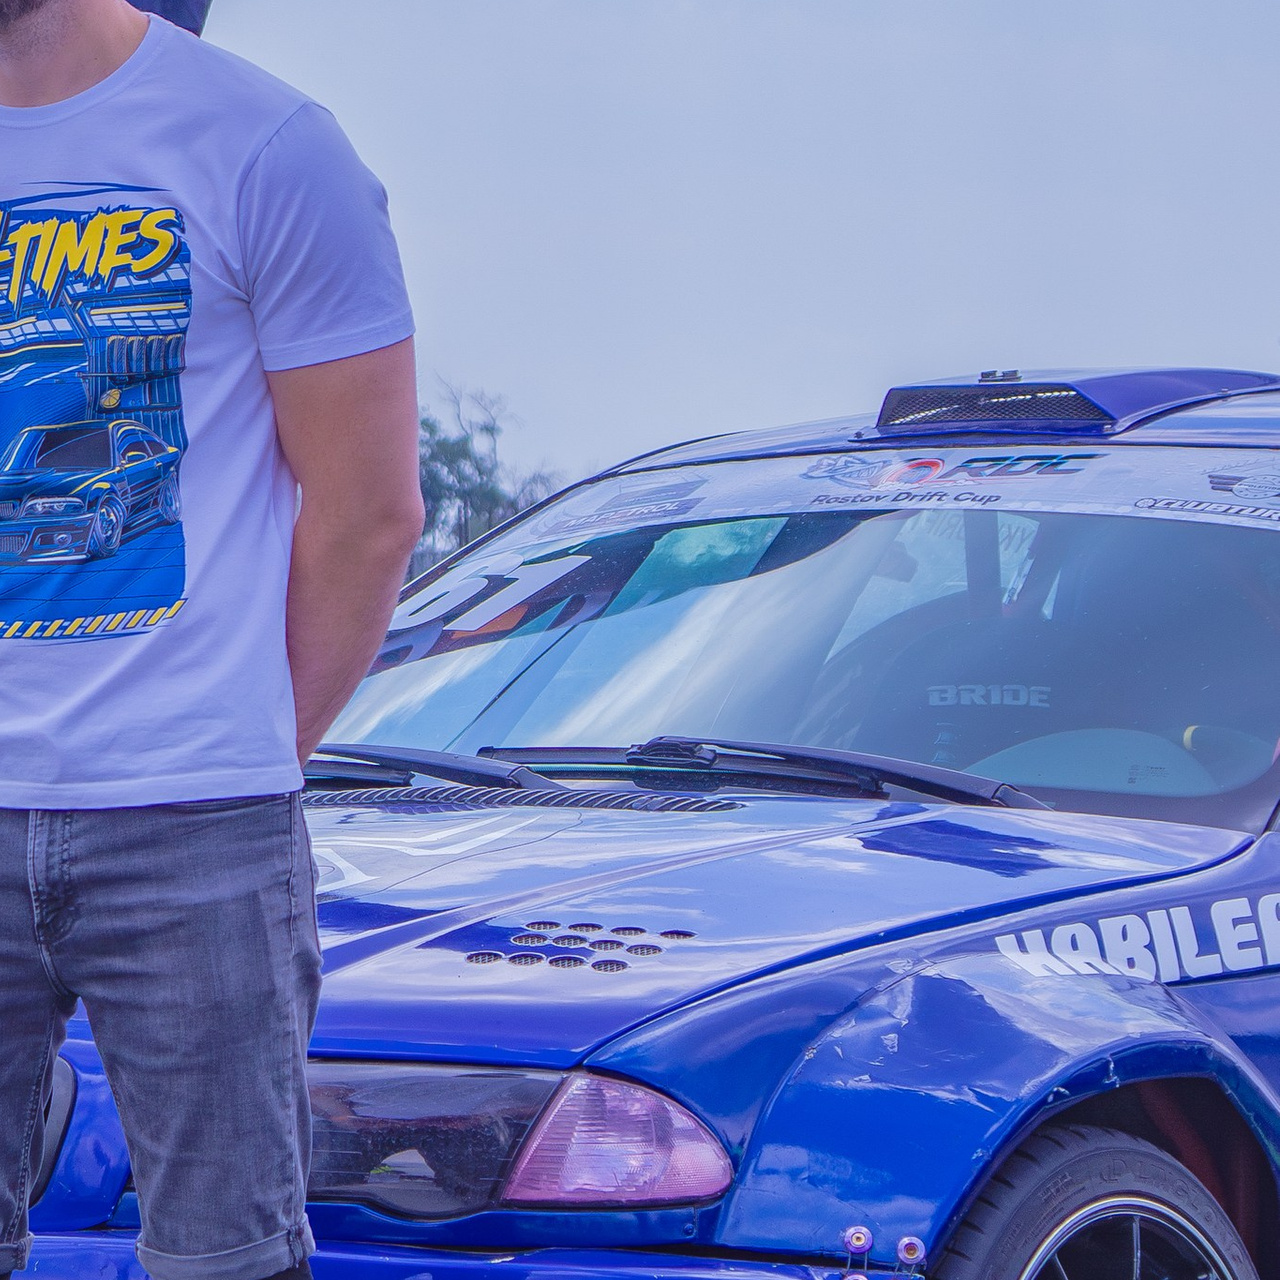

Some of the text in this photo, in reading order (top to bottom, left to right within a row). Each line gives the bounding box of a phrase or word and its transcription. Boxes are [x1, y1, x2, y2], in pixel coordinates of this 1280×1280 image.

[810, 491, 1002, 506] Rostov Drift Cup
[927, 685, 1051, 707] BRIDE
